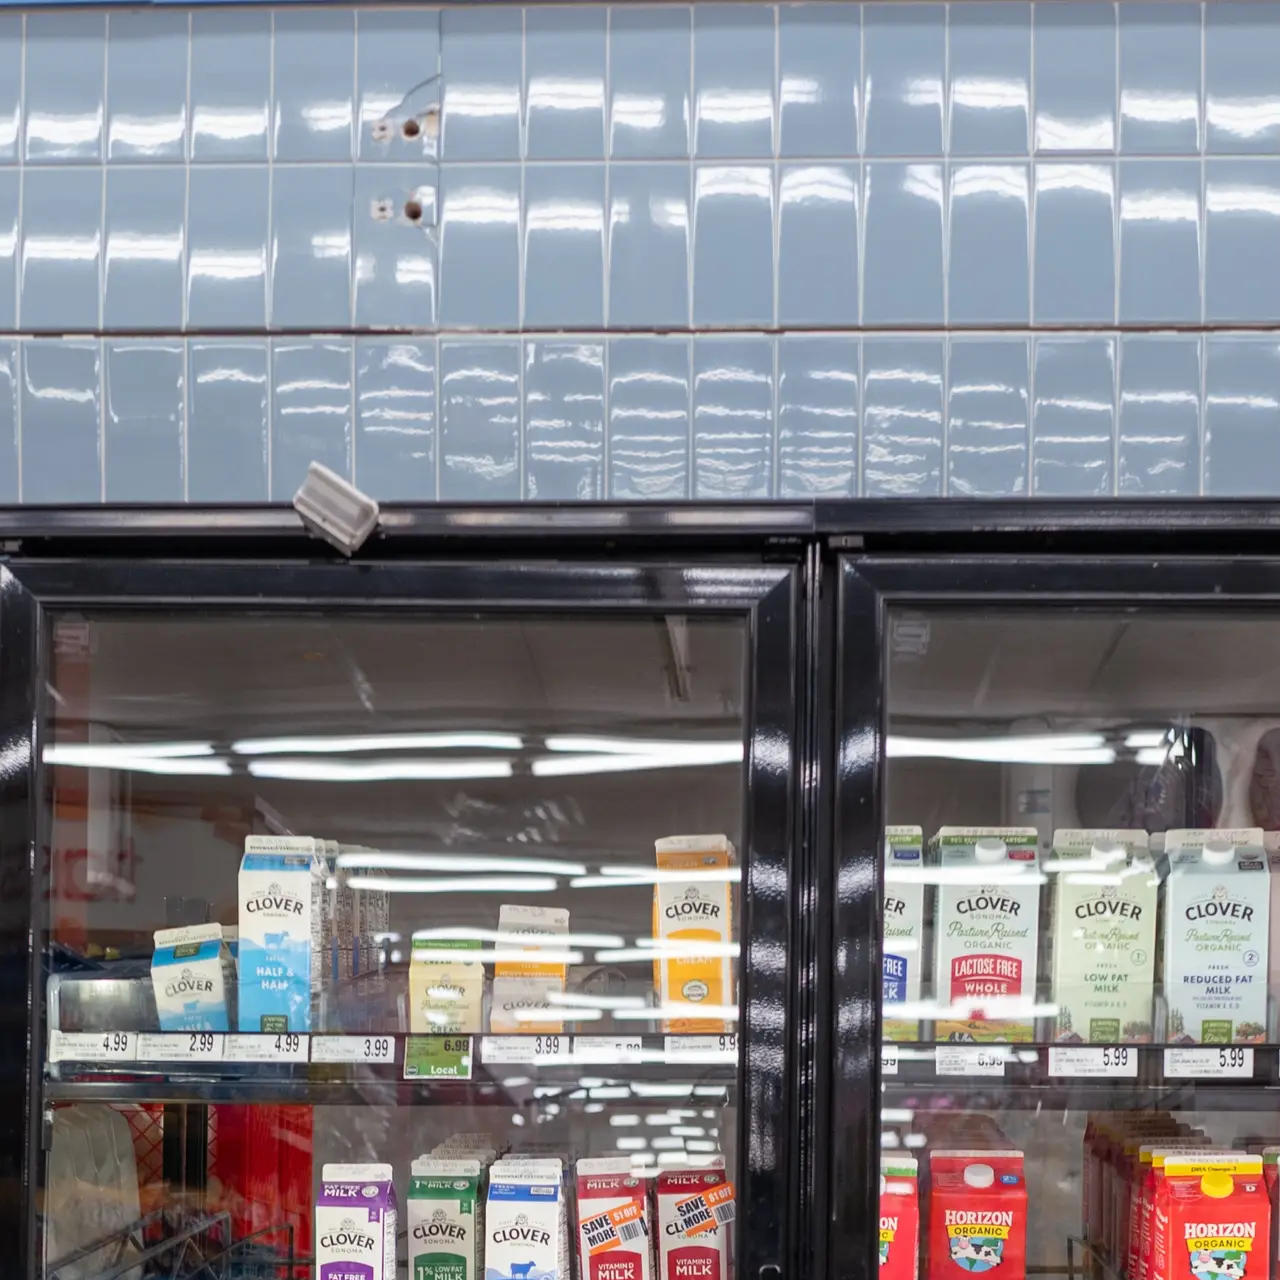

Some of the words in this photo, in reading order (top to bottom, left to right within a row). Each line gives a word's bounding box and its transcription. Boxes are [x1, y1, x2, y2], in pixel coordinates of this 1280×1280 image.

[246, 898, 303, 915] CLOVER
[665, 902, 719, 919] CLOVER
[956, 897, 1020, 916] CLOVER
[964, 941, 1012, 949] ORGANIC
[257, 967, 284, 977] HALF
[286, 967, 294, 977] &
[955, 957, 994, 977] LACTOSE
[997, 956, 1018, 977] FREE
[262, 979, 288, 989] HALF
[964, 983, 1007, 993] WHOLE
[102, 1034, 128, 1052] 4.99
[189, 1035, 214, 1052] 2.99
[364, 1040, 388, 1057] 3.99
[444, 1040, 469, 1052] 6.99
[535, 1038, 560, 1054] 3.99
[1103, 1048, 1128, 1066] 5.99
[1219, 1049, 1244, 1068] 5.99
[431, 1065, 457, 1075] Local
[622, 1205, 640, 1217] OFF
[945, 1210, 1012, 1226] HORIZON
[582, 1214, 611, 1235] SAVE
[954, 1226, 1003, 1237] ORGANIC
[321, 1235, 375, 1250] CLOVER
[587, 1227, 617, 1247] MORE
